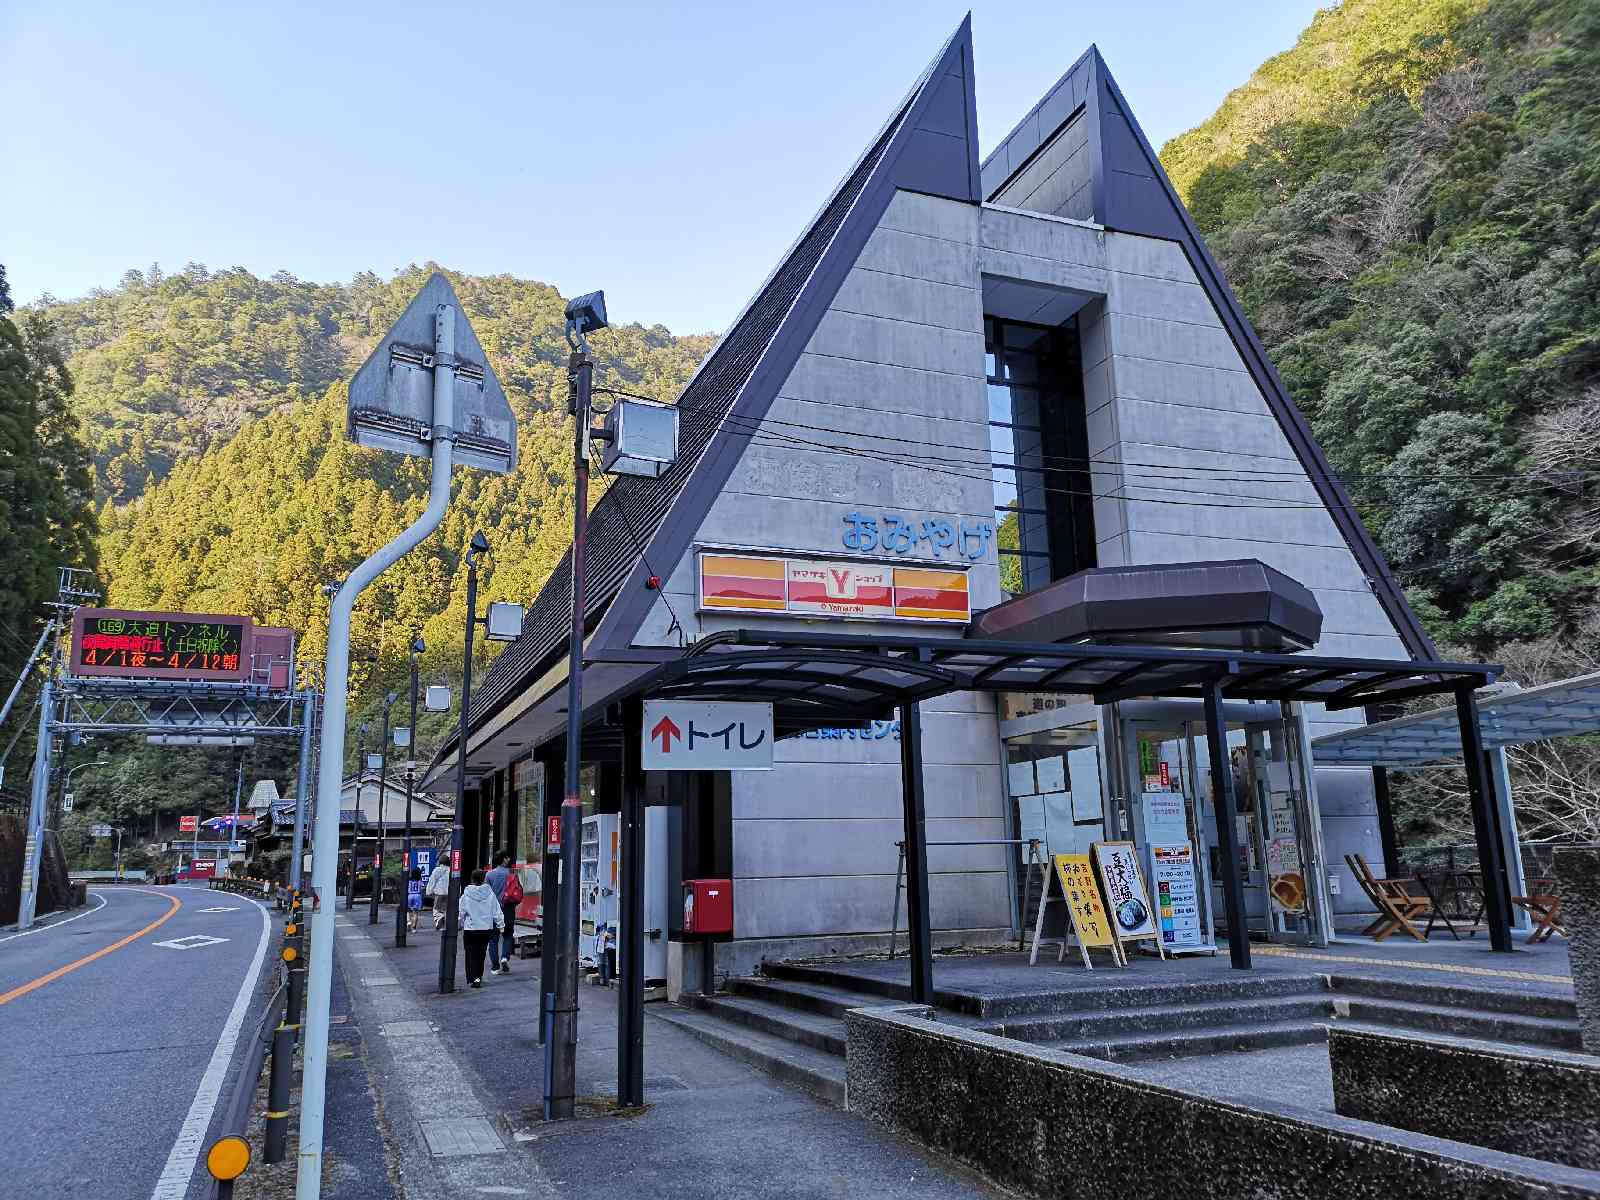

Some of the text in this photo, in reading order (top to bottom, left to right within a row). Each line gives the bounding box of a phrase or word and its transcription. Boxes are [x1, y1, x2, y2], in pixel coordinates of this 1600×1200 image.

[842, 512, 993, 560] おみやげ
[830, 568, 850, 594] Y
[688, 719, 765, 750] トイレ
